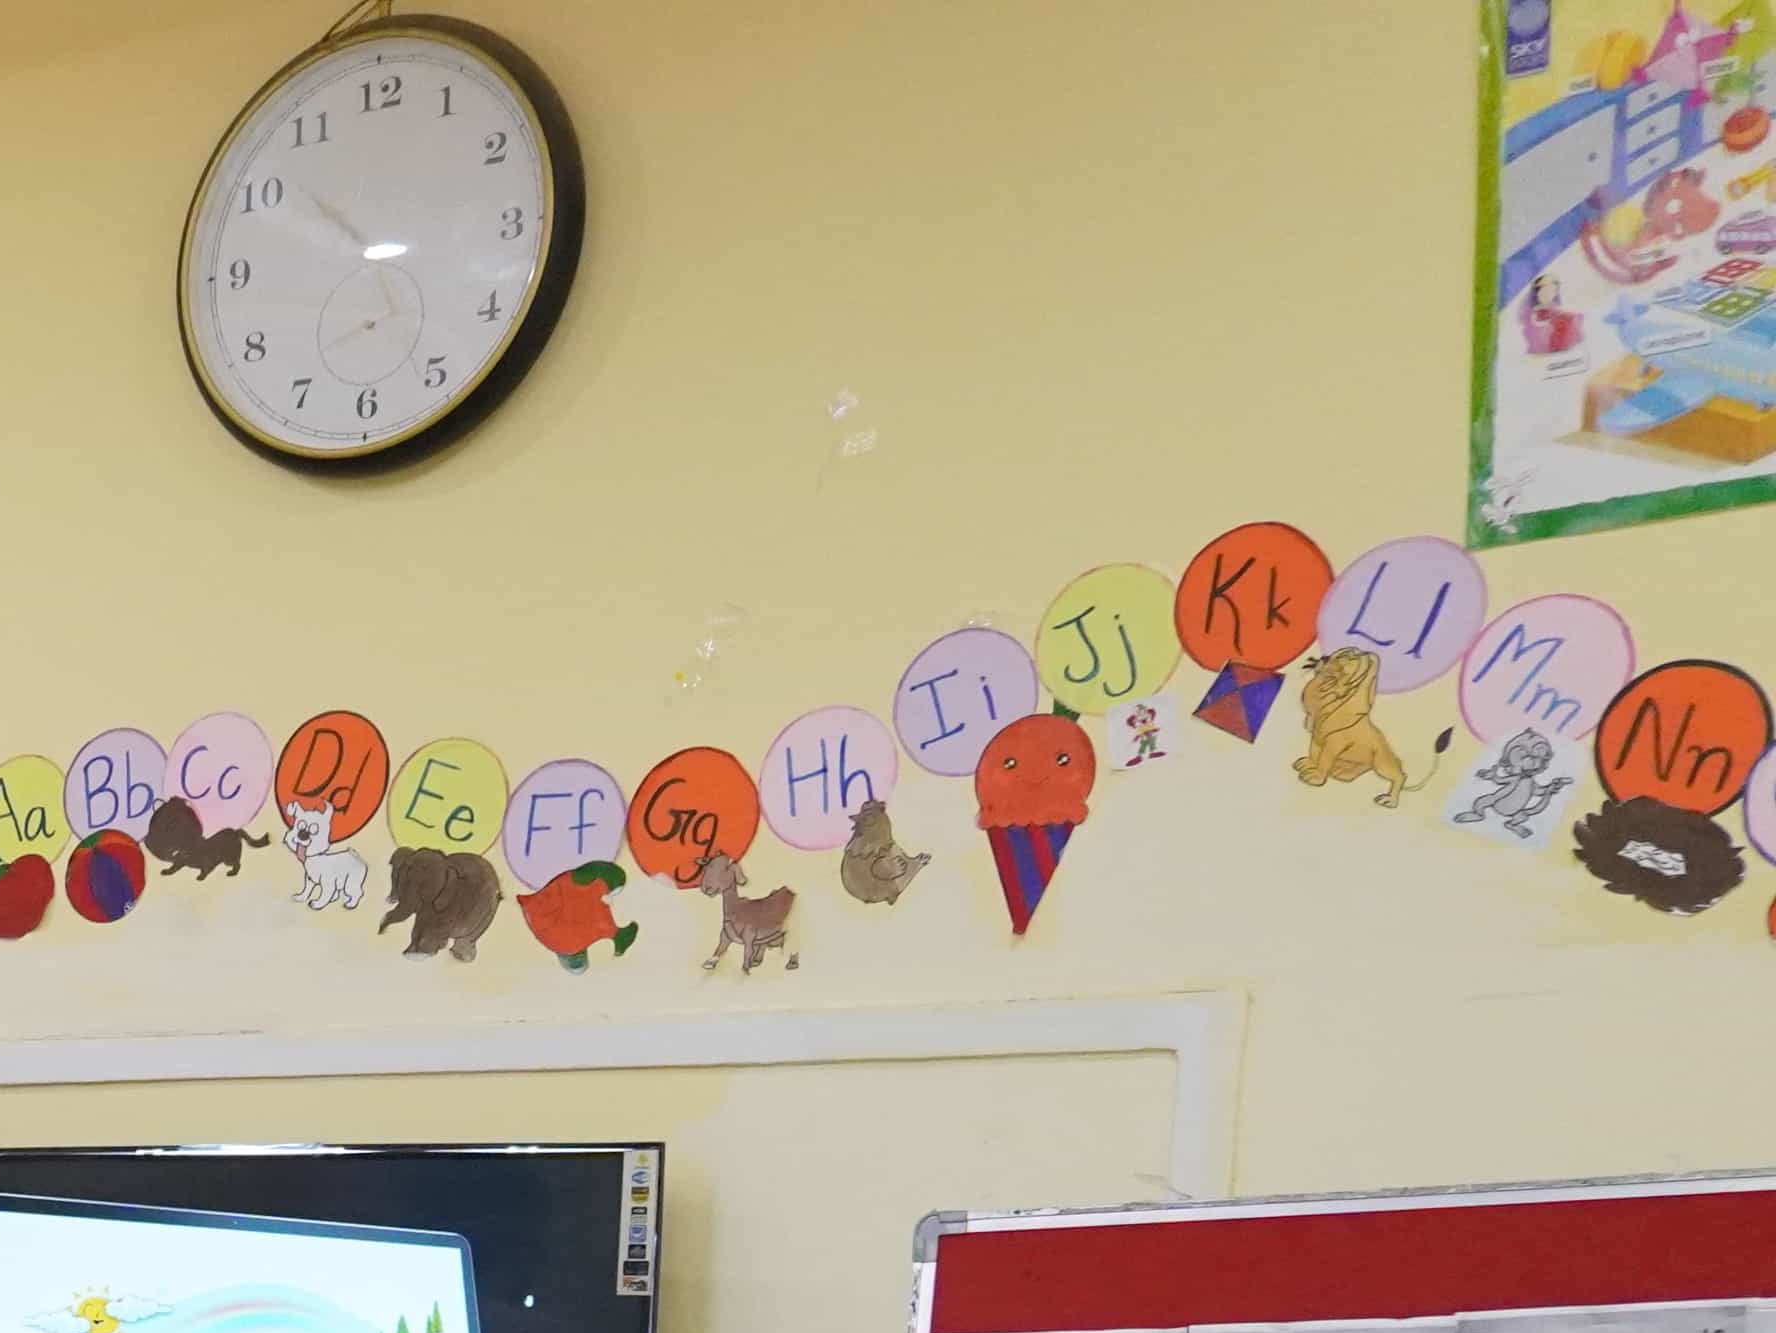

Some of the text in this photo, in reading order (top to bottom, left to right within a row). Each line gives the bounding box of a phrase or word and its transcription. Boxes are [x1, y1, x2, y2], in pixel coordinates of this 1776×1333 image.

[359, 75, 402, 113] 12
[439, 85, 456, 118] 1
[290, 112, 330, 149] 11
[484, 131, 507, 165] 2
[240, 177, 283, 214] 10
[500, 207, 524, 240] 3
[229, 259, 251, 290] 9
[477, 289, 501, 323] 4
[244, 331, 266, 362] 8
[291, 378, 312, 410] 7
[424, 355, 447, 388] 5
[356, 388, 378, 419] 6
[1204, 554, 1291, 655] Kk
[1347, 561, 1451, 659] Ll
[1053, 605, 1137, 697] Jj
[1472, 623, 1584, 732] Mm
[910, 669, 997, 750] Ii
[1615, 697, 1733, 794] Nn
[83, 750, 153, 829] Bb
[181, 745, 241, 800] Cc
[293, 729, 372, 815] Dd
[786, 734, 873, 817] Hh
[404, 758, 475, 842] Ee
[525, 788, 604, 856] Ff
